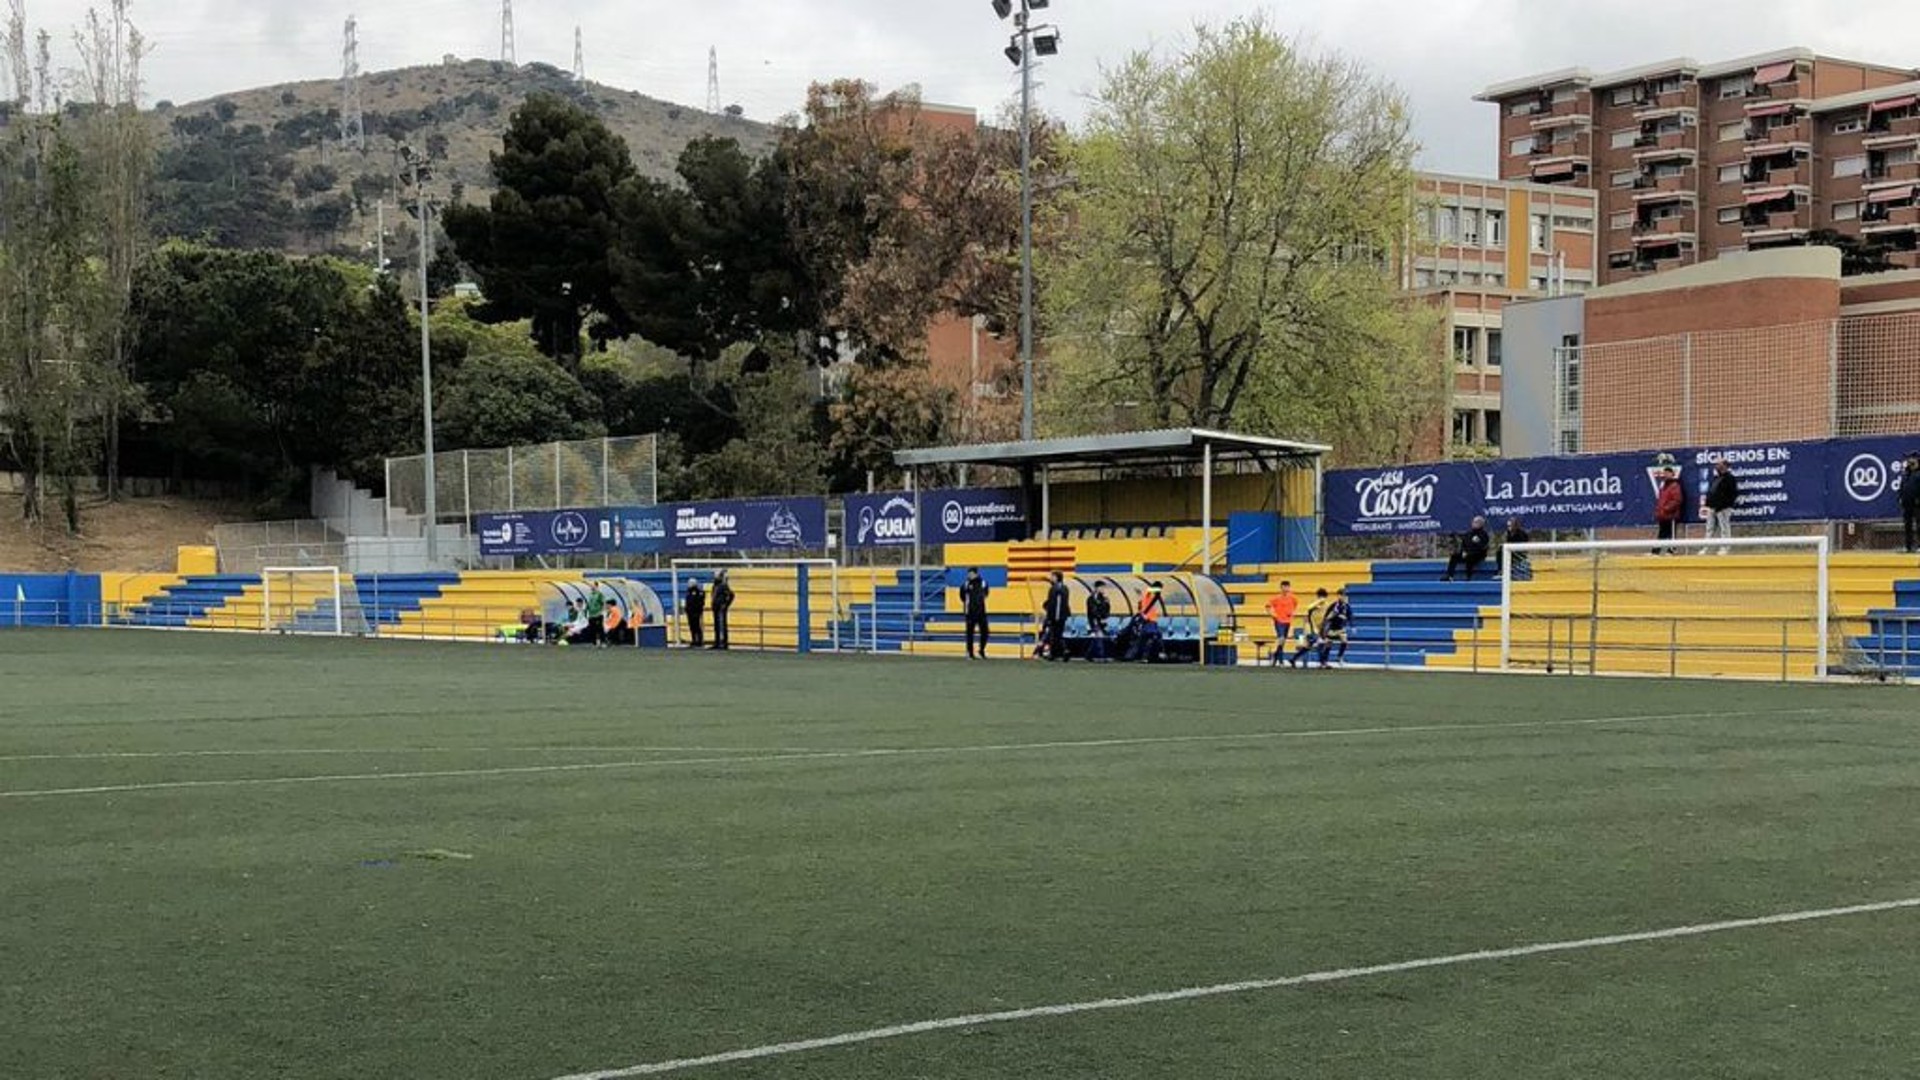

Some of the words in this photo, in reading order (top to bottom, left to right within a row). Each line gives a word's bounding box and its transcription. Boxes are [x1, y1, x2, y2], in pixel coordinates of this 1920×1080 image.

[1696, 448, 1765, 464] SÍGUENOS
[1767, 447, 1790, 461] EN:
[1355, 474, 1439, 517] Castro
[1485, 474, 1514, 500] La
[1520, 467, 1622, 498] Locanda
[1484, 503, 1547, 516] VERAMENTE
